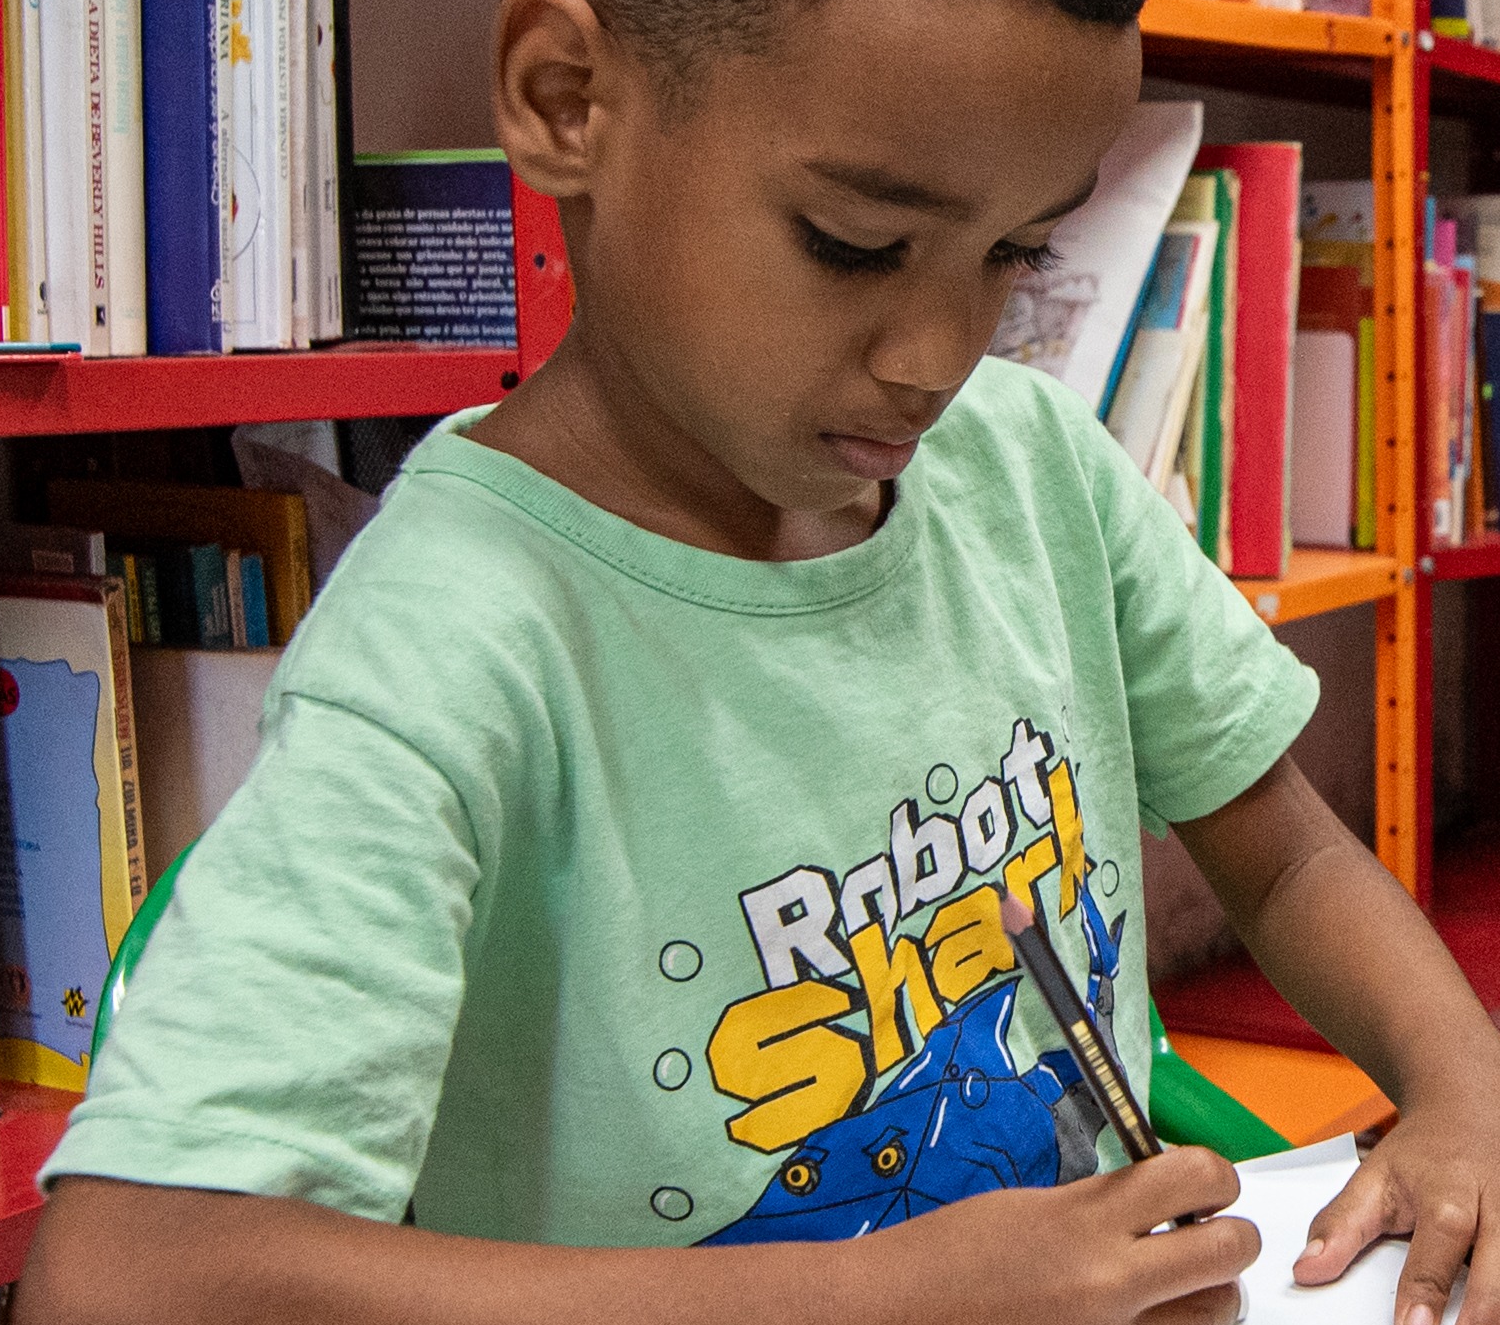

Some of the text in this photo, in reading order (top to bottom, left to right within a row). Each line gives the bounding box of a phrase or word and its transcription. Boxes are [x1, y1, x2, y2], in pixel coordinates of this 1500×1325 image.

[88, 0, 106, 289] A DIETA DE BEVERLY HILLS
[122, 779, 139, 850] ZULMIRA
[741, 717, 1057, 992] Robot
[705, 757, 1095, 1157] Shark
